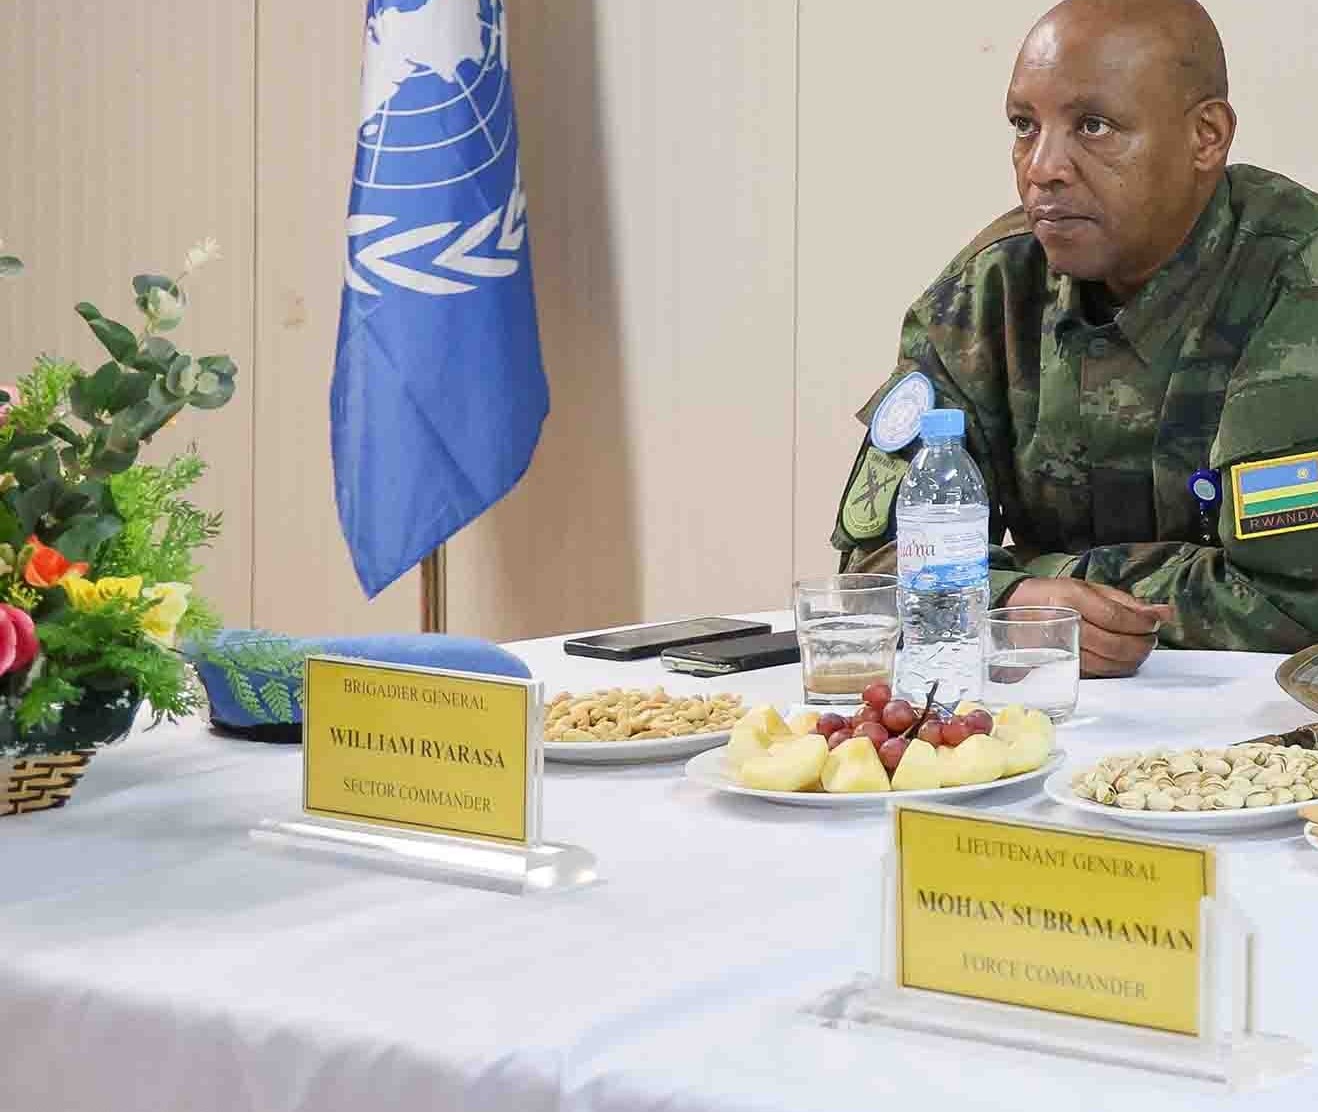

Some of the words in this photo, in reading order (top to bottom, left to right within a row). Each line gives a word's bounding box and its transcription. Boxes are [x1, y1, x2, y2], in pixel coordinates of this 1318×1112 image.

[343, 678, 418, 703] BRIGADIER
[422, 688, 489, 711] GENERAL
[329, 726, 415, 757] WILLIAM
[420, 739, 506, 768] RYARASA
[343, 778, 396, 800] SECTOR
[399, 786, 492, 813] COMMANDER
[955, 835, 1067, 868] LIEUTENANT
[1072, 852, 1160, 882] GENERAL
[916, 888, 1005, 922] MOHAN
[1011, 904, 1194, 952] SUBRAMANIAN
[960, 951, 1018, 976] FORCE
[1023, 963, 1147, 1000] COMMANDER
